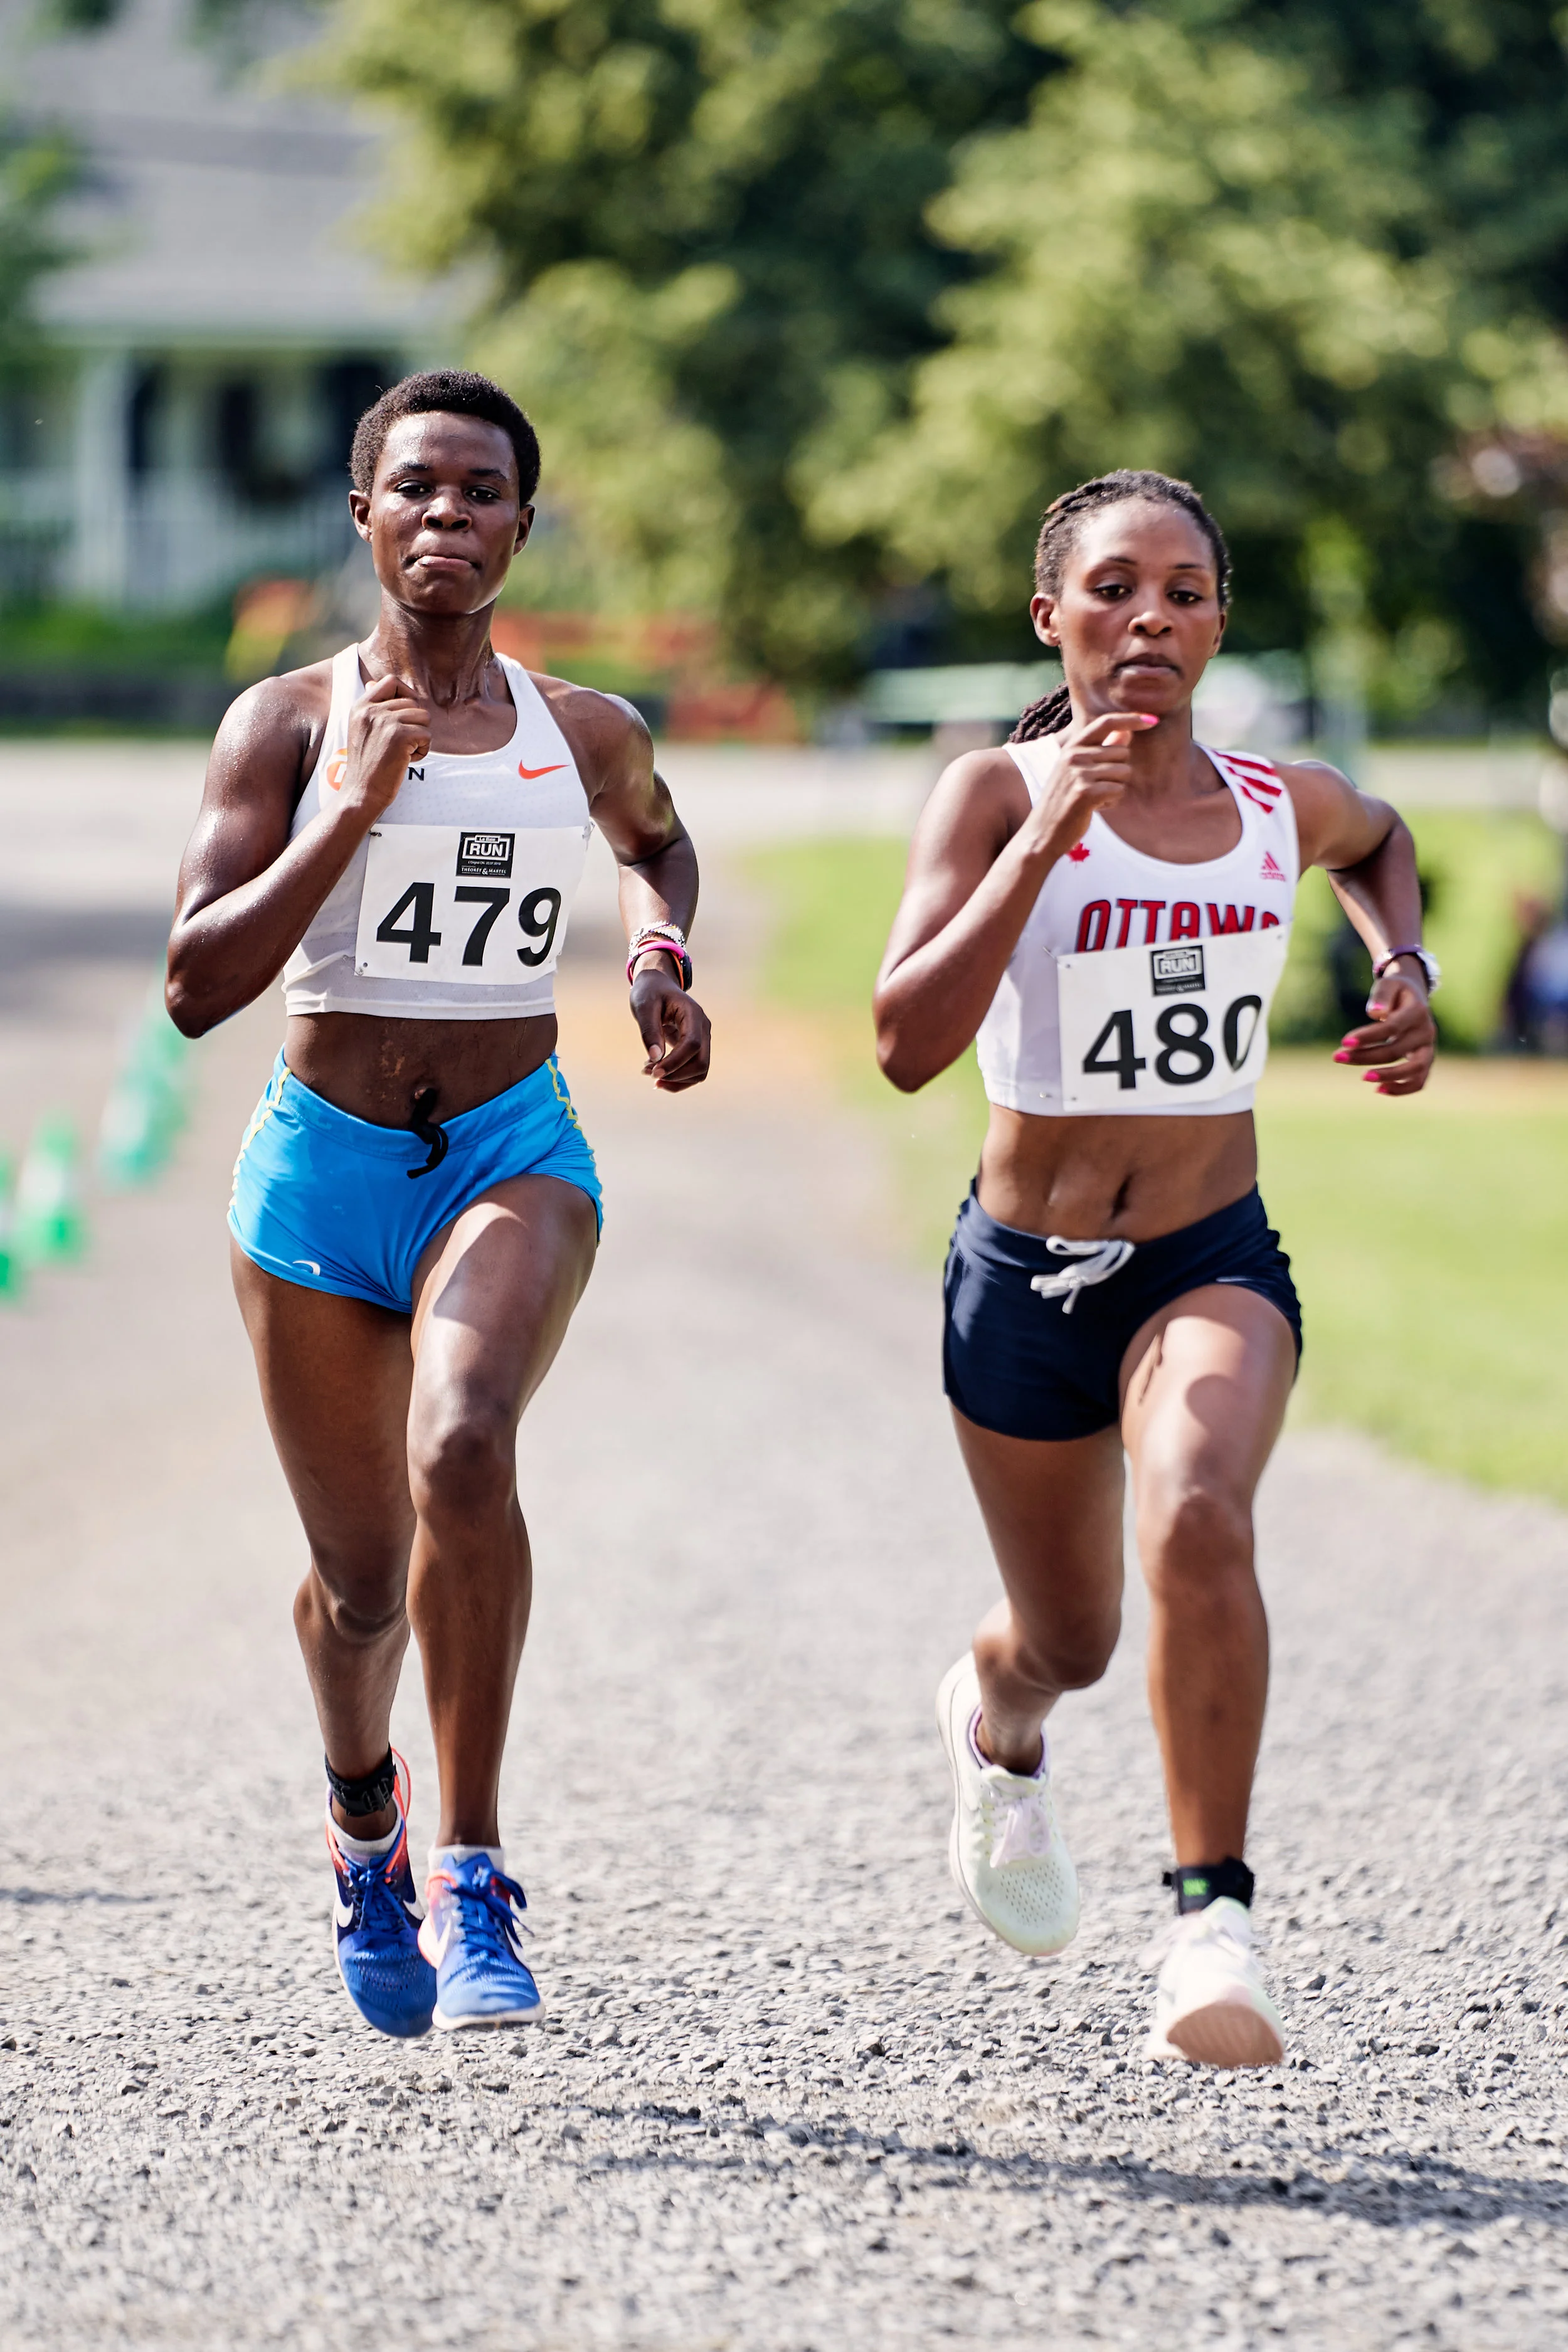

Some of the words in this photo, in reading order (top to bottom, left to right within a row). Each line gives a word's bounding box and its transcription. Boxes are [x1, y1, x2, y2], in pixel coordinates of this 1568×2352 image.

[469, 843, 503, 857] RUN
[376, 882, 561, 967] 479
[1160, 957, 1195, 974] RUN
[1083, 995, 1261, 1089] 480
